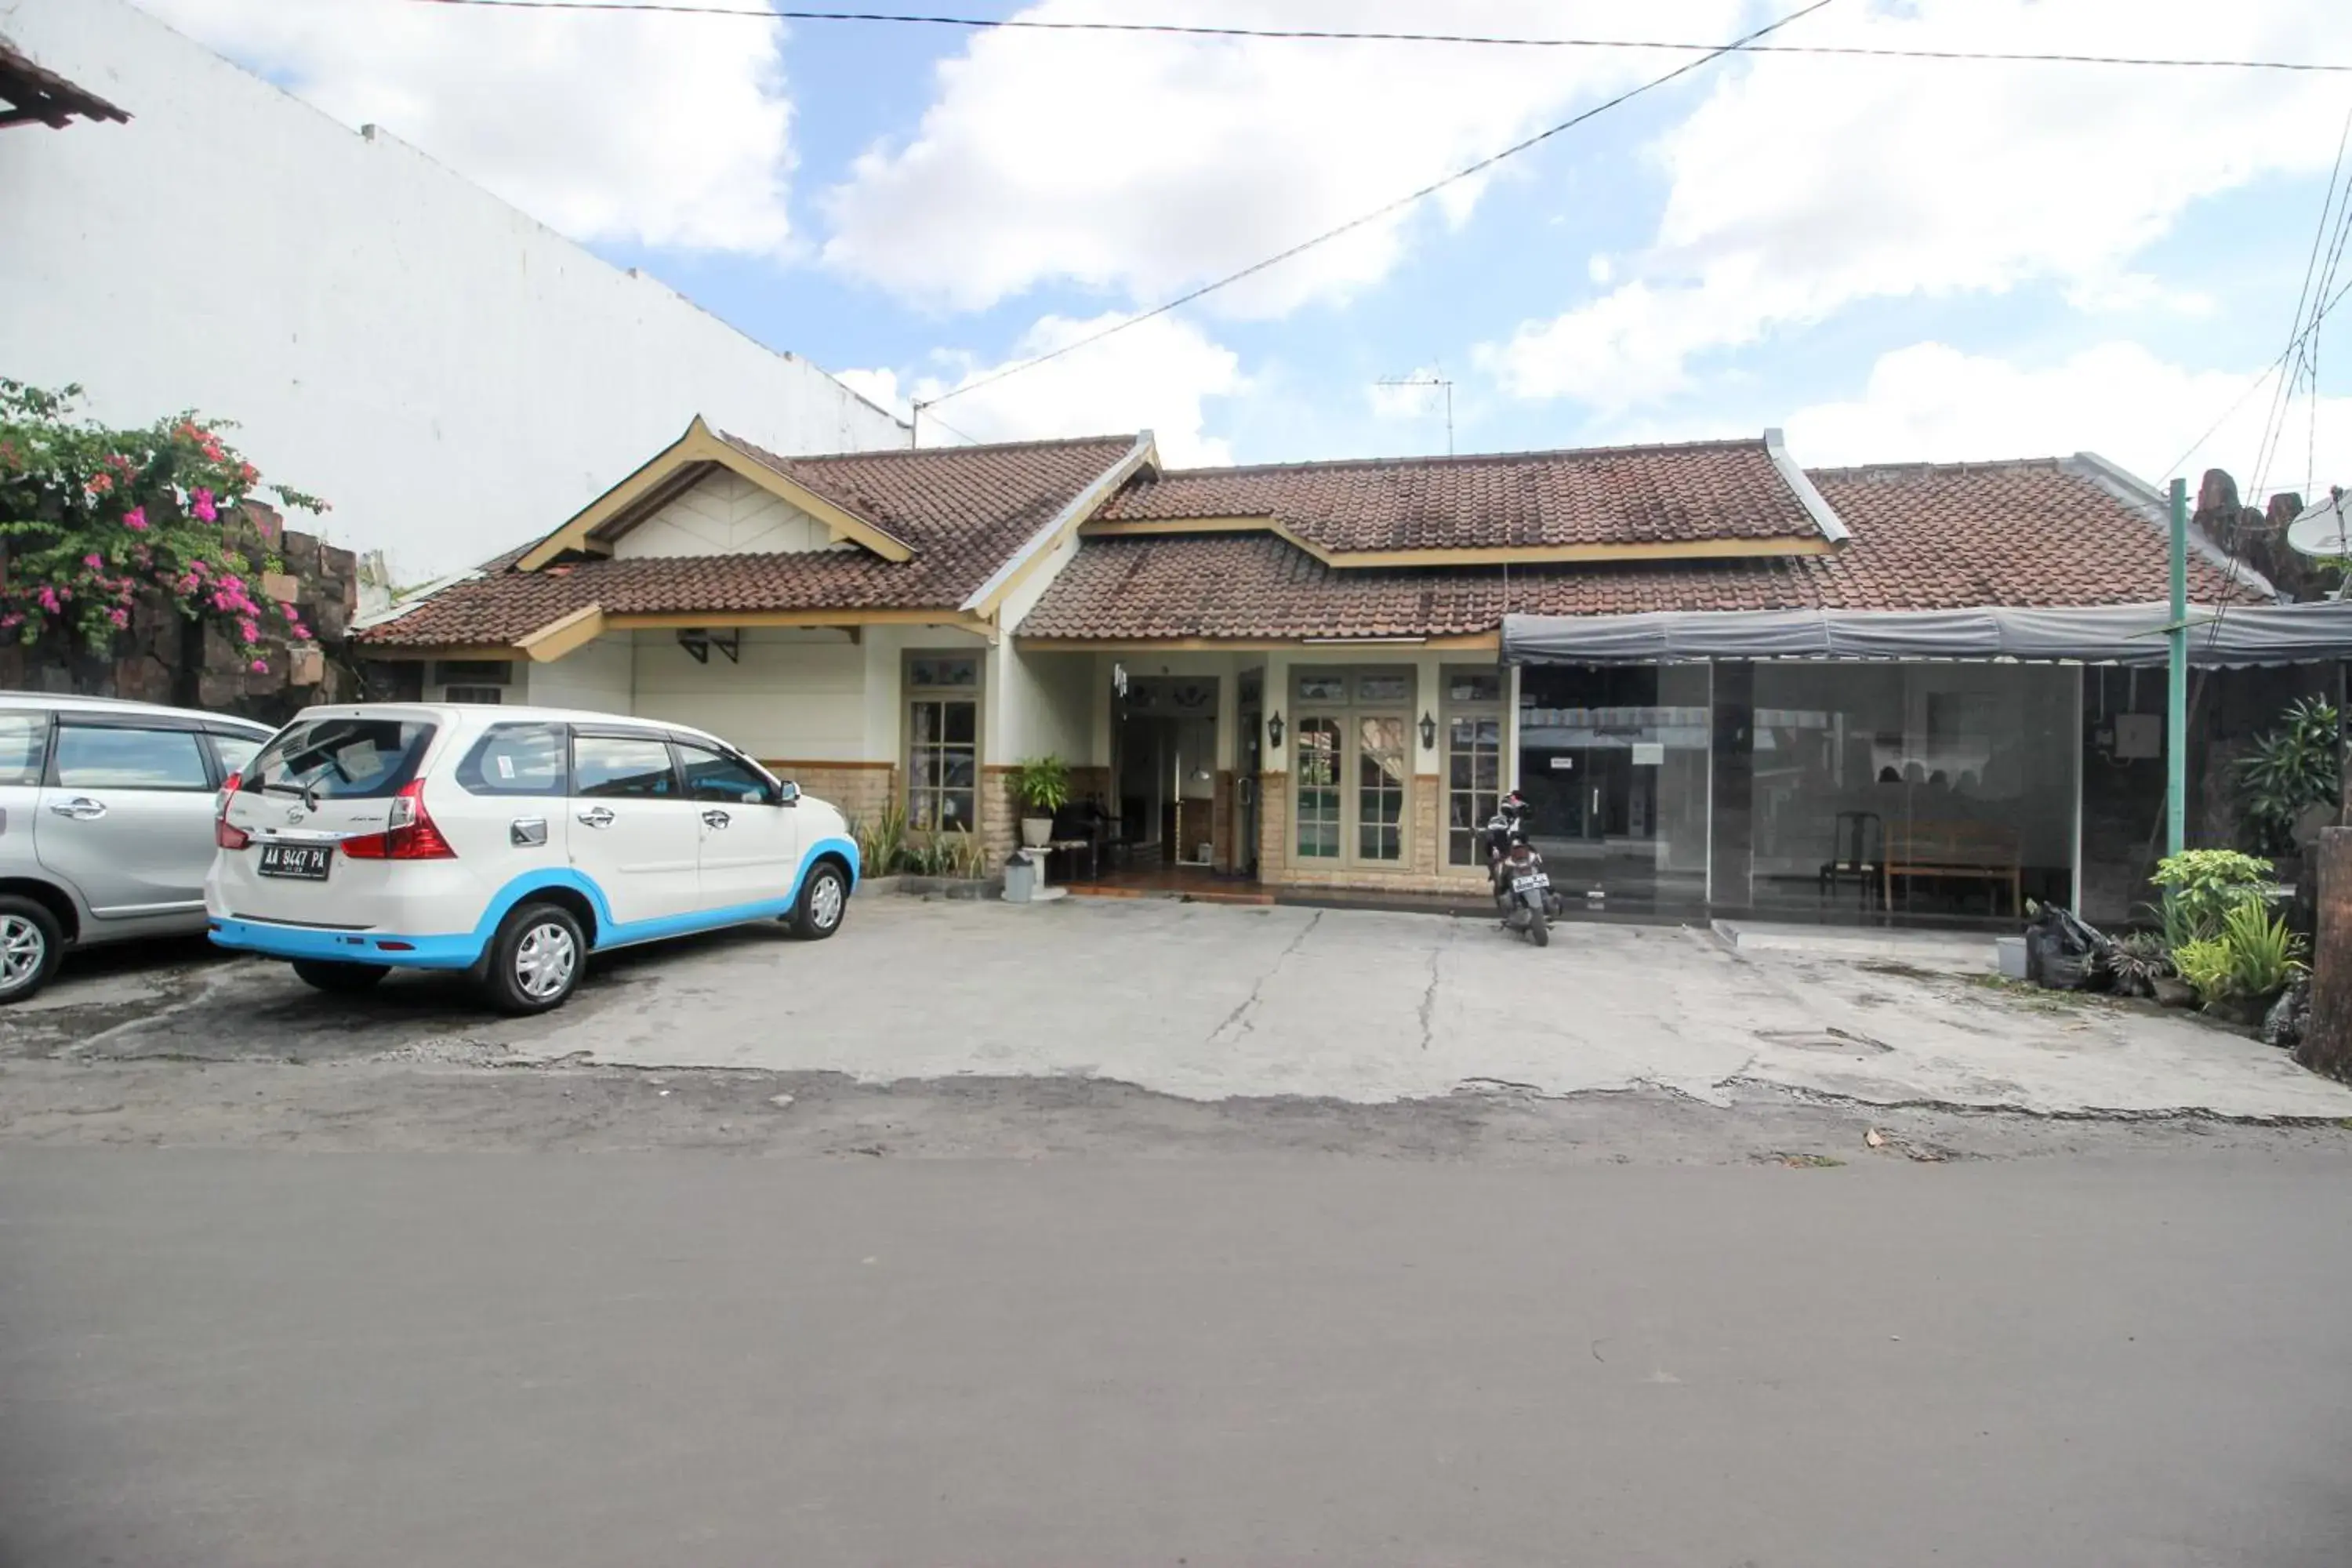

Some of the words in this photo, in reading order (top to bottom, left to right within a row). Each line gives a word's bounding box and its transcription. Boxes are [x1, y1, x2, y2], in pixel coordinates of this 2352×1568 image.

[265, 848, 279, 865] AA
[283, 849, 308, 866] 9447
[310, 851, 324, 868] PA
